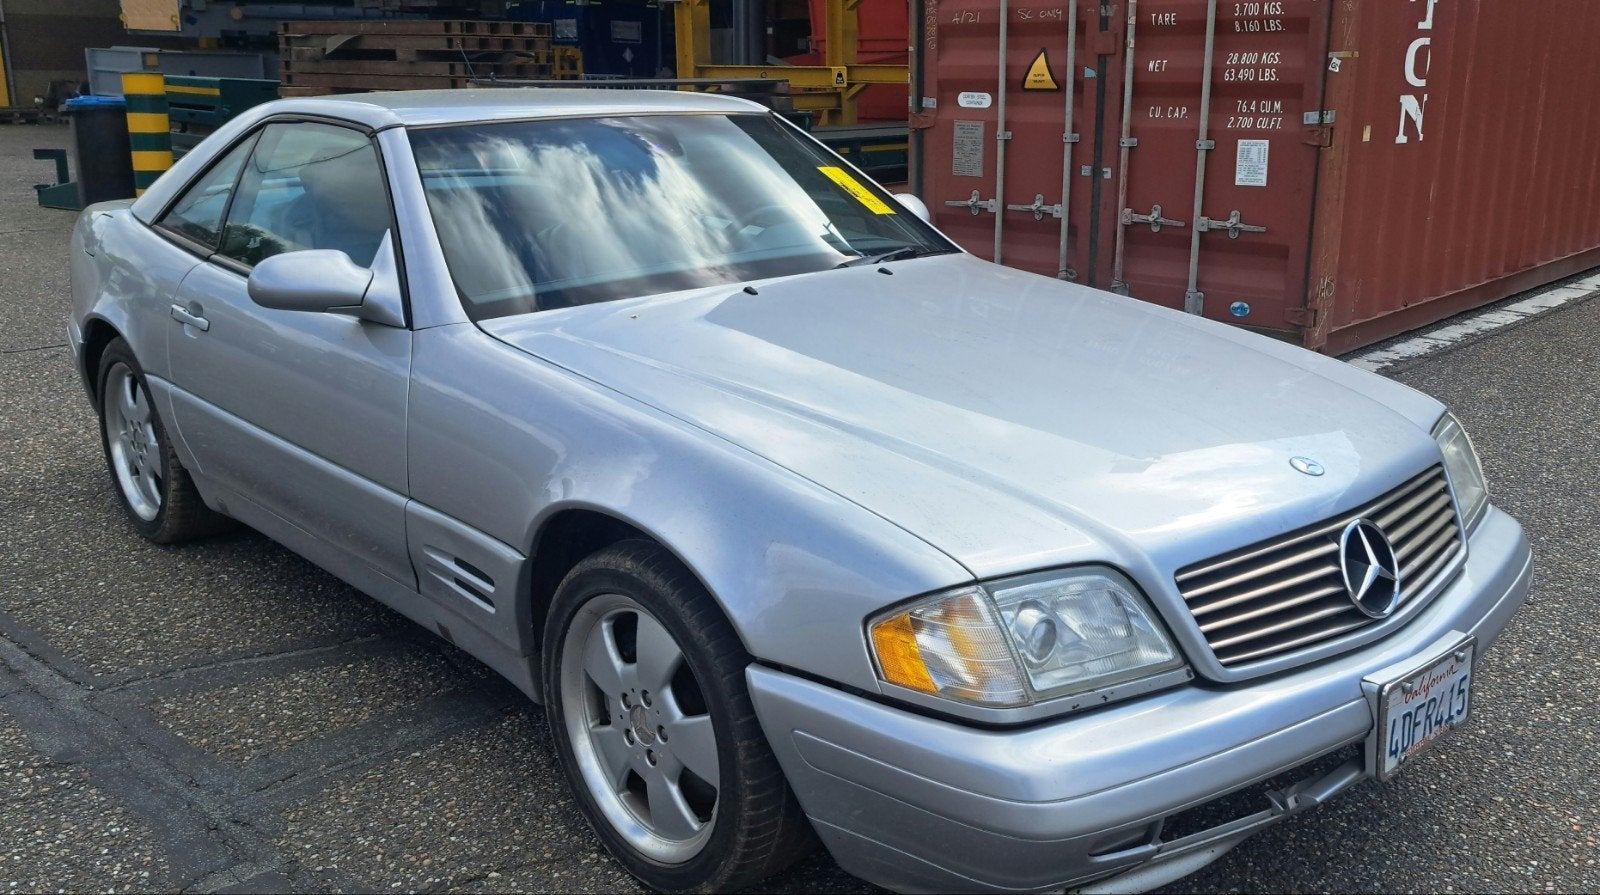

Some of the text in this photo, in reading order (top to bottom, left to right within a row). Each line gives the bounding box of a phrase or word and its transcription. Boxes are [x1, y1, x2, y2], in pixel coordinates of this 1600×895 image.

[1263, 2, 1285, 15] KGS.
[1151, 13, 1177, 26] TARE
[1234, 19, 1286, 32] 8.160 LBS.
[1226, 52, 1281, 64] 28.800 KGS.
[1148, 60, 1168, 72] NET
[1258, 68, 1279, 81] LBS.
[1149, 106, 1188, 118] CU. CAP.
[1237, 100, 1256, 113] 76.4
[1227, 116, 1253, 128] 2.700
[1388, 675, 1468, 759] 4DFR415
